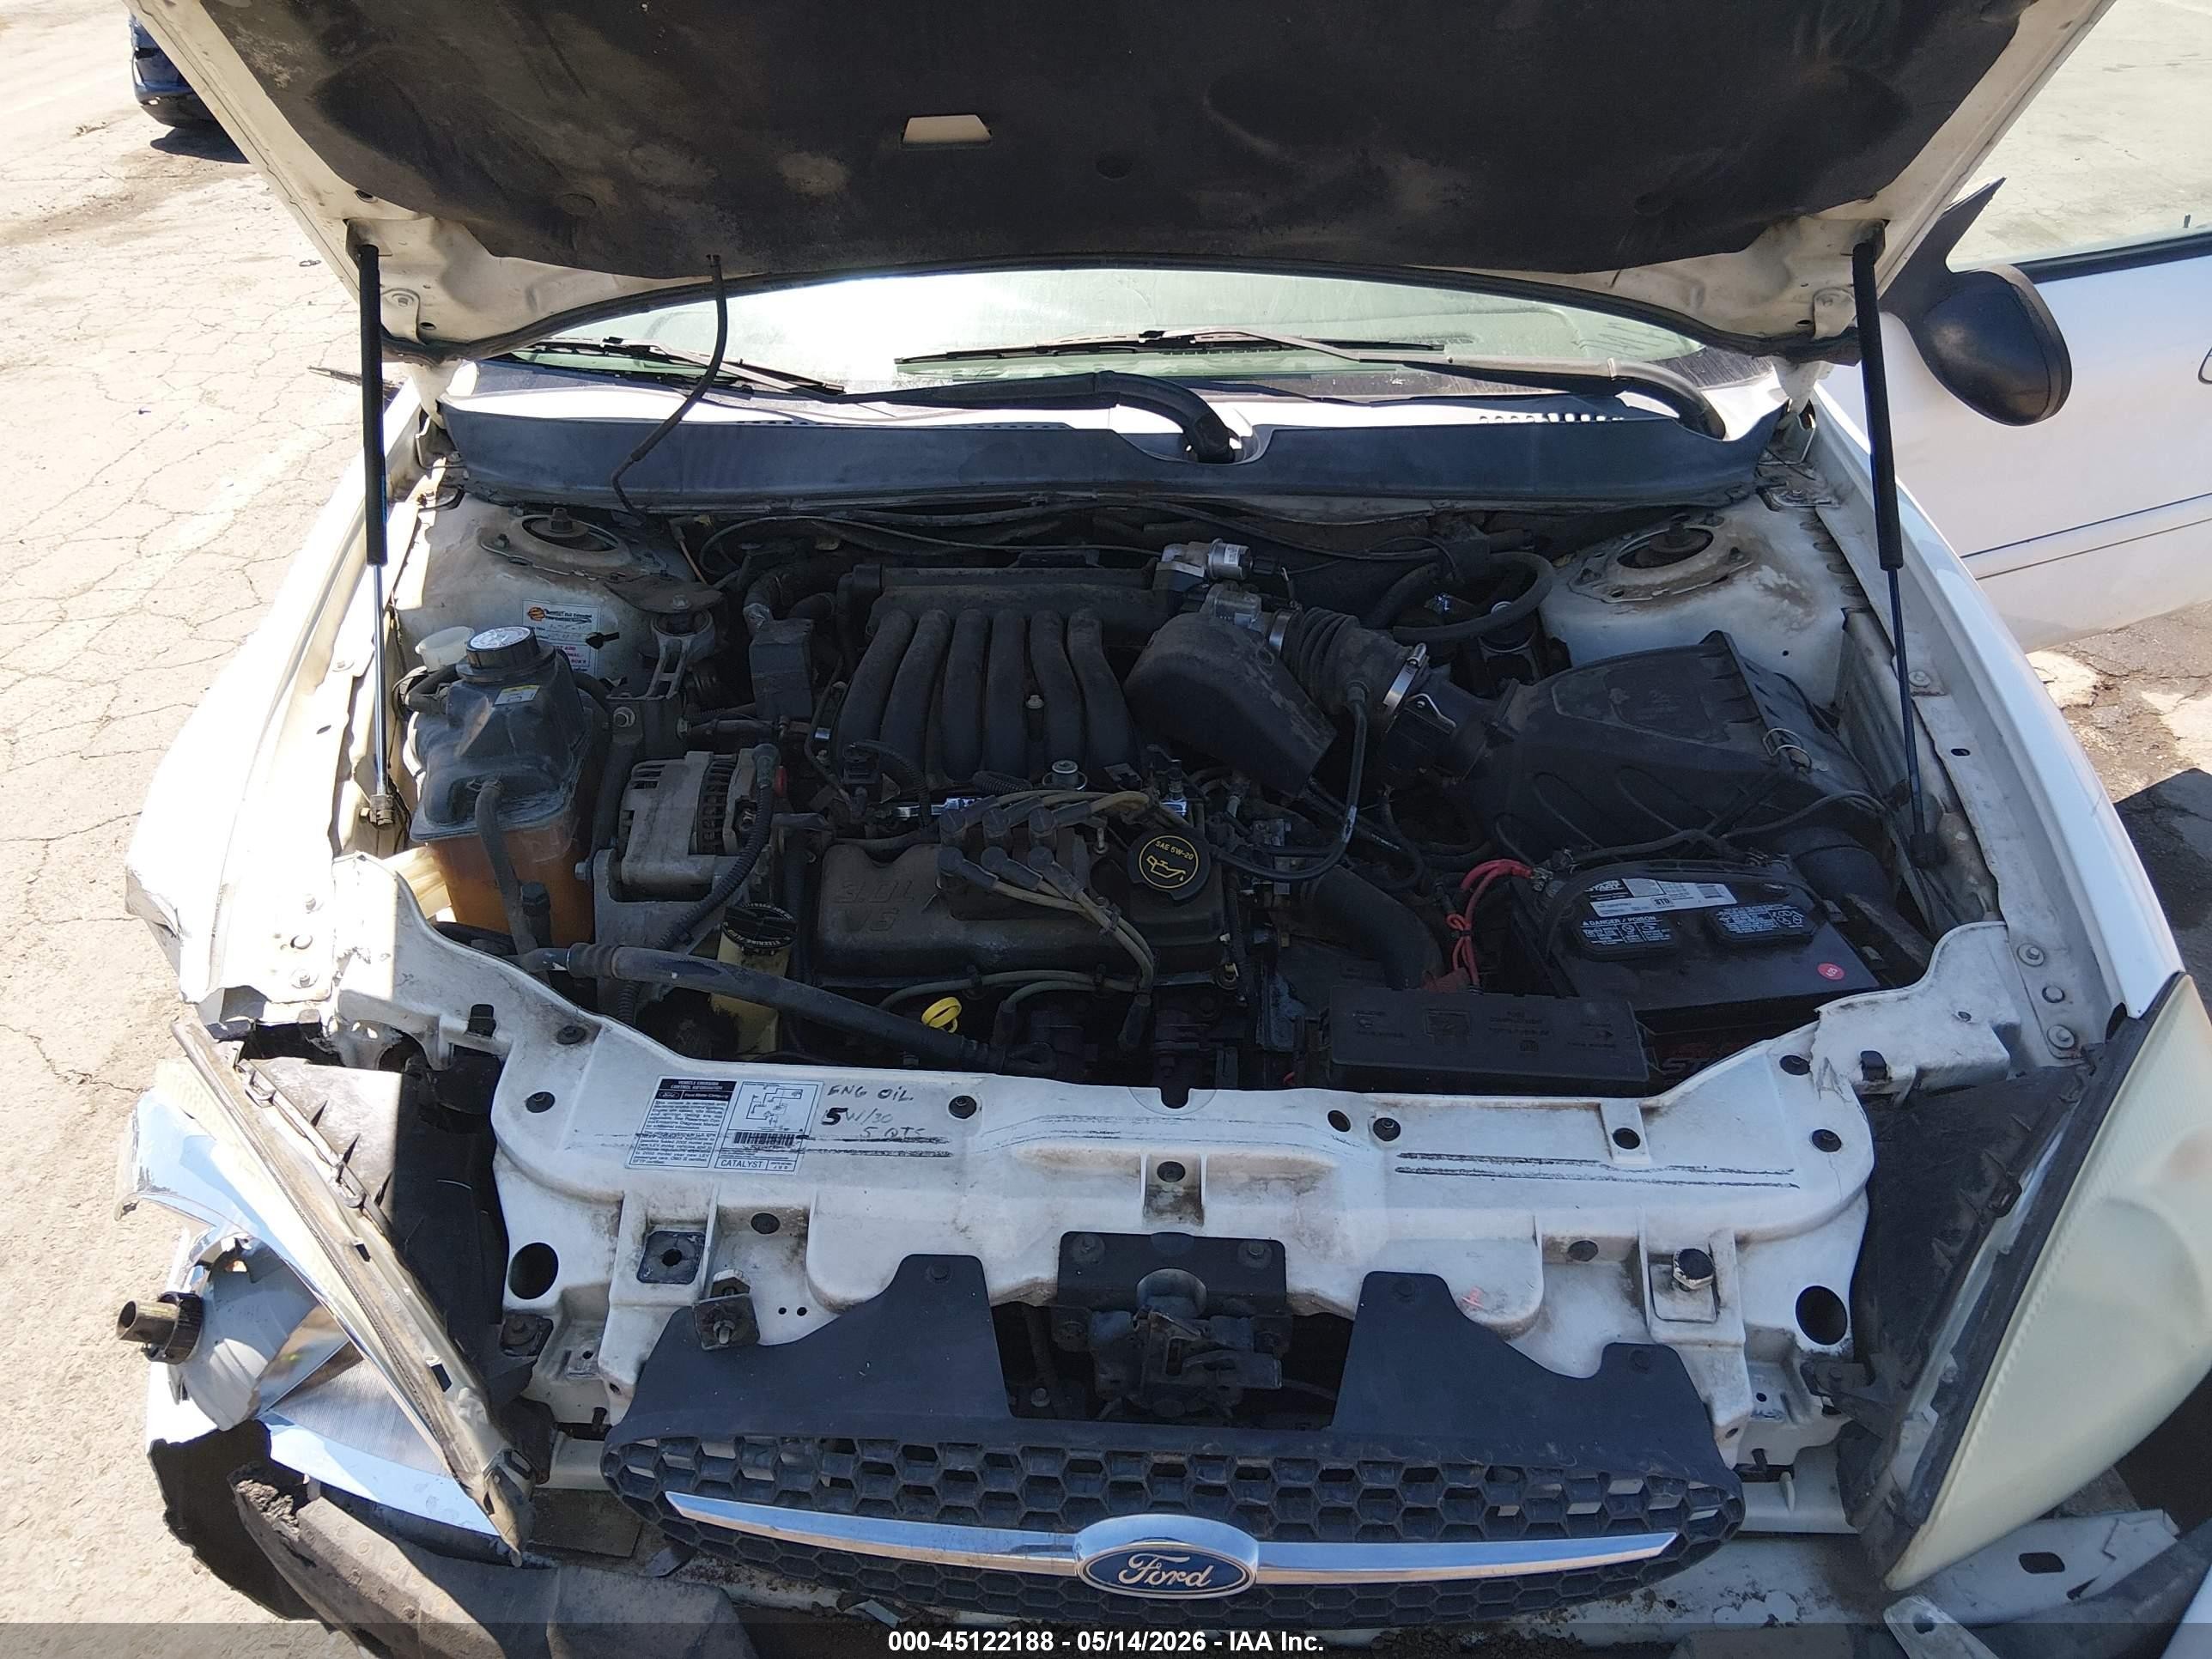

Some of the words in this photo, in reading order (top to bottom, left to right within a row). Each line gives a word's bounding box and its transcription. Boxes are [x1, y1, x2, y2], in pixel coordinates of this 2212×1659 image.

[1155, 841, 1170, 851] SAE
[827, 1085, 867, 1098] ENG
[821, 1107, 894, 1126] 5W/30
[720, 1159, 764, 1169] CATALYST
[1117, 1552, 1216, 1589] Ford
